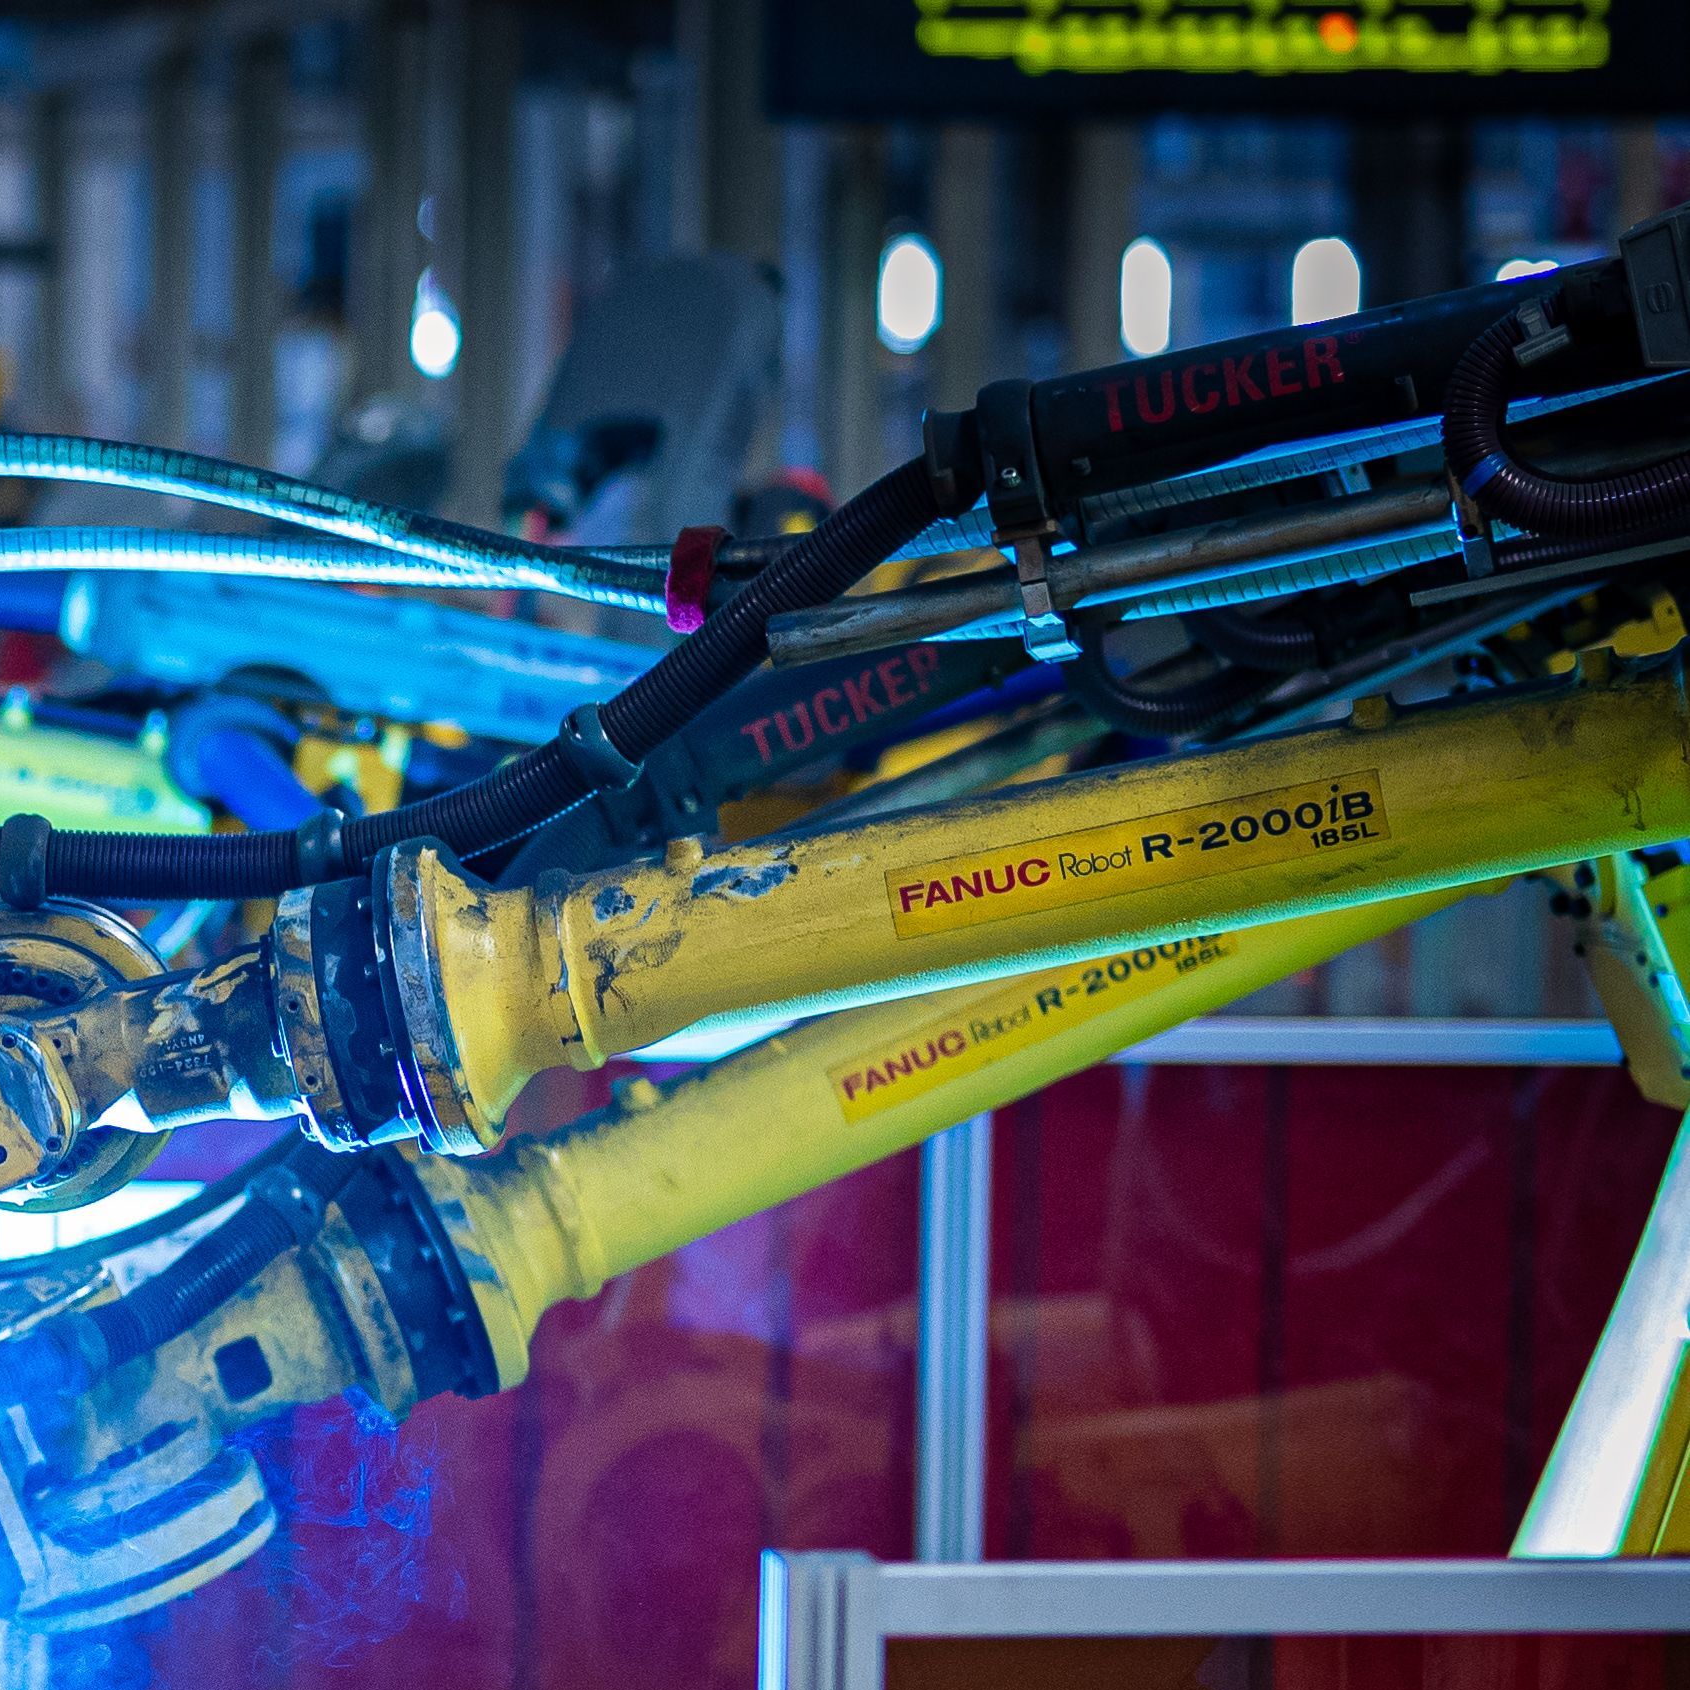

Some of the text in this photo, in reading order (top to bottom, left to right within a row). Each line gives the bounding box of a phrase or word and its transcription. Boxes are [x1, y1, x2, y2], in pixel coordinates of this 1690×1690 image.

[1092, 335, 1346, 434] TUCKER
[898, 784, 1375, 914] FANUC Robot R-2000iB
[1310, 825, 1380, 849] 185L
[841, 1029, 967, 1101] FANUC
